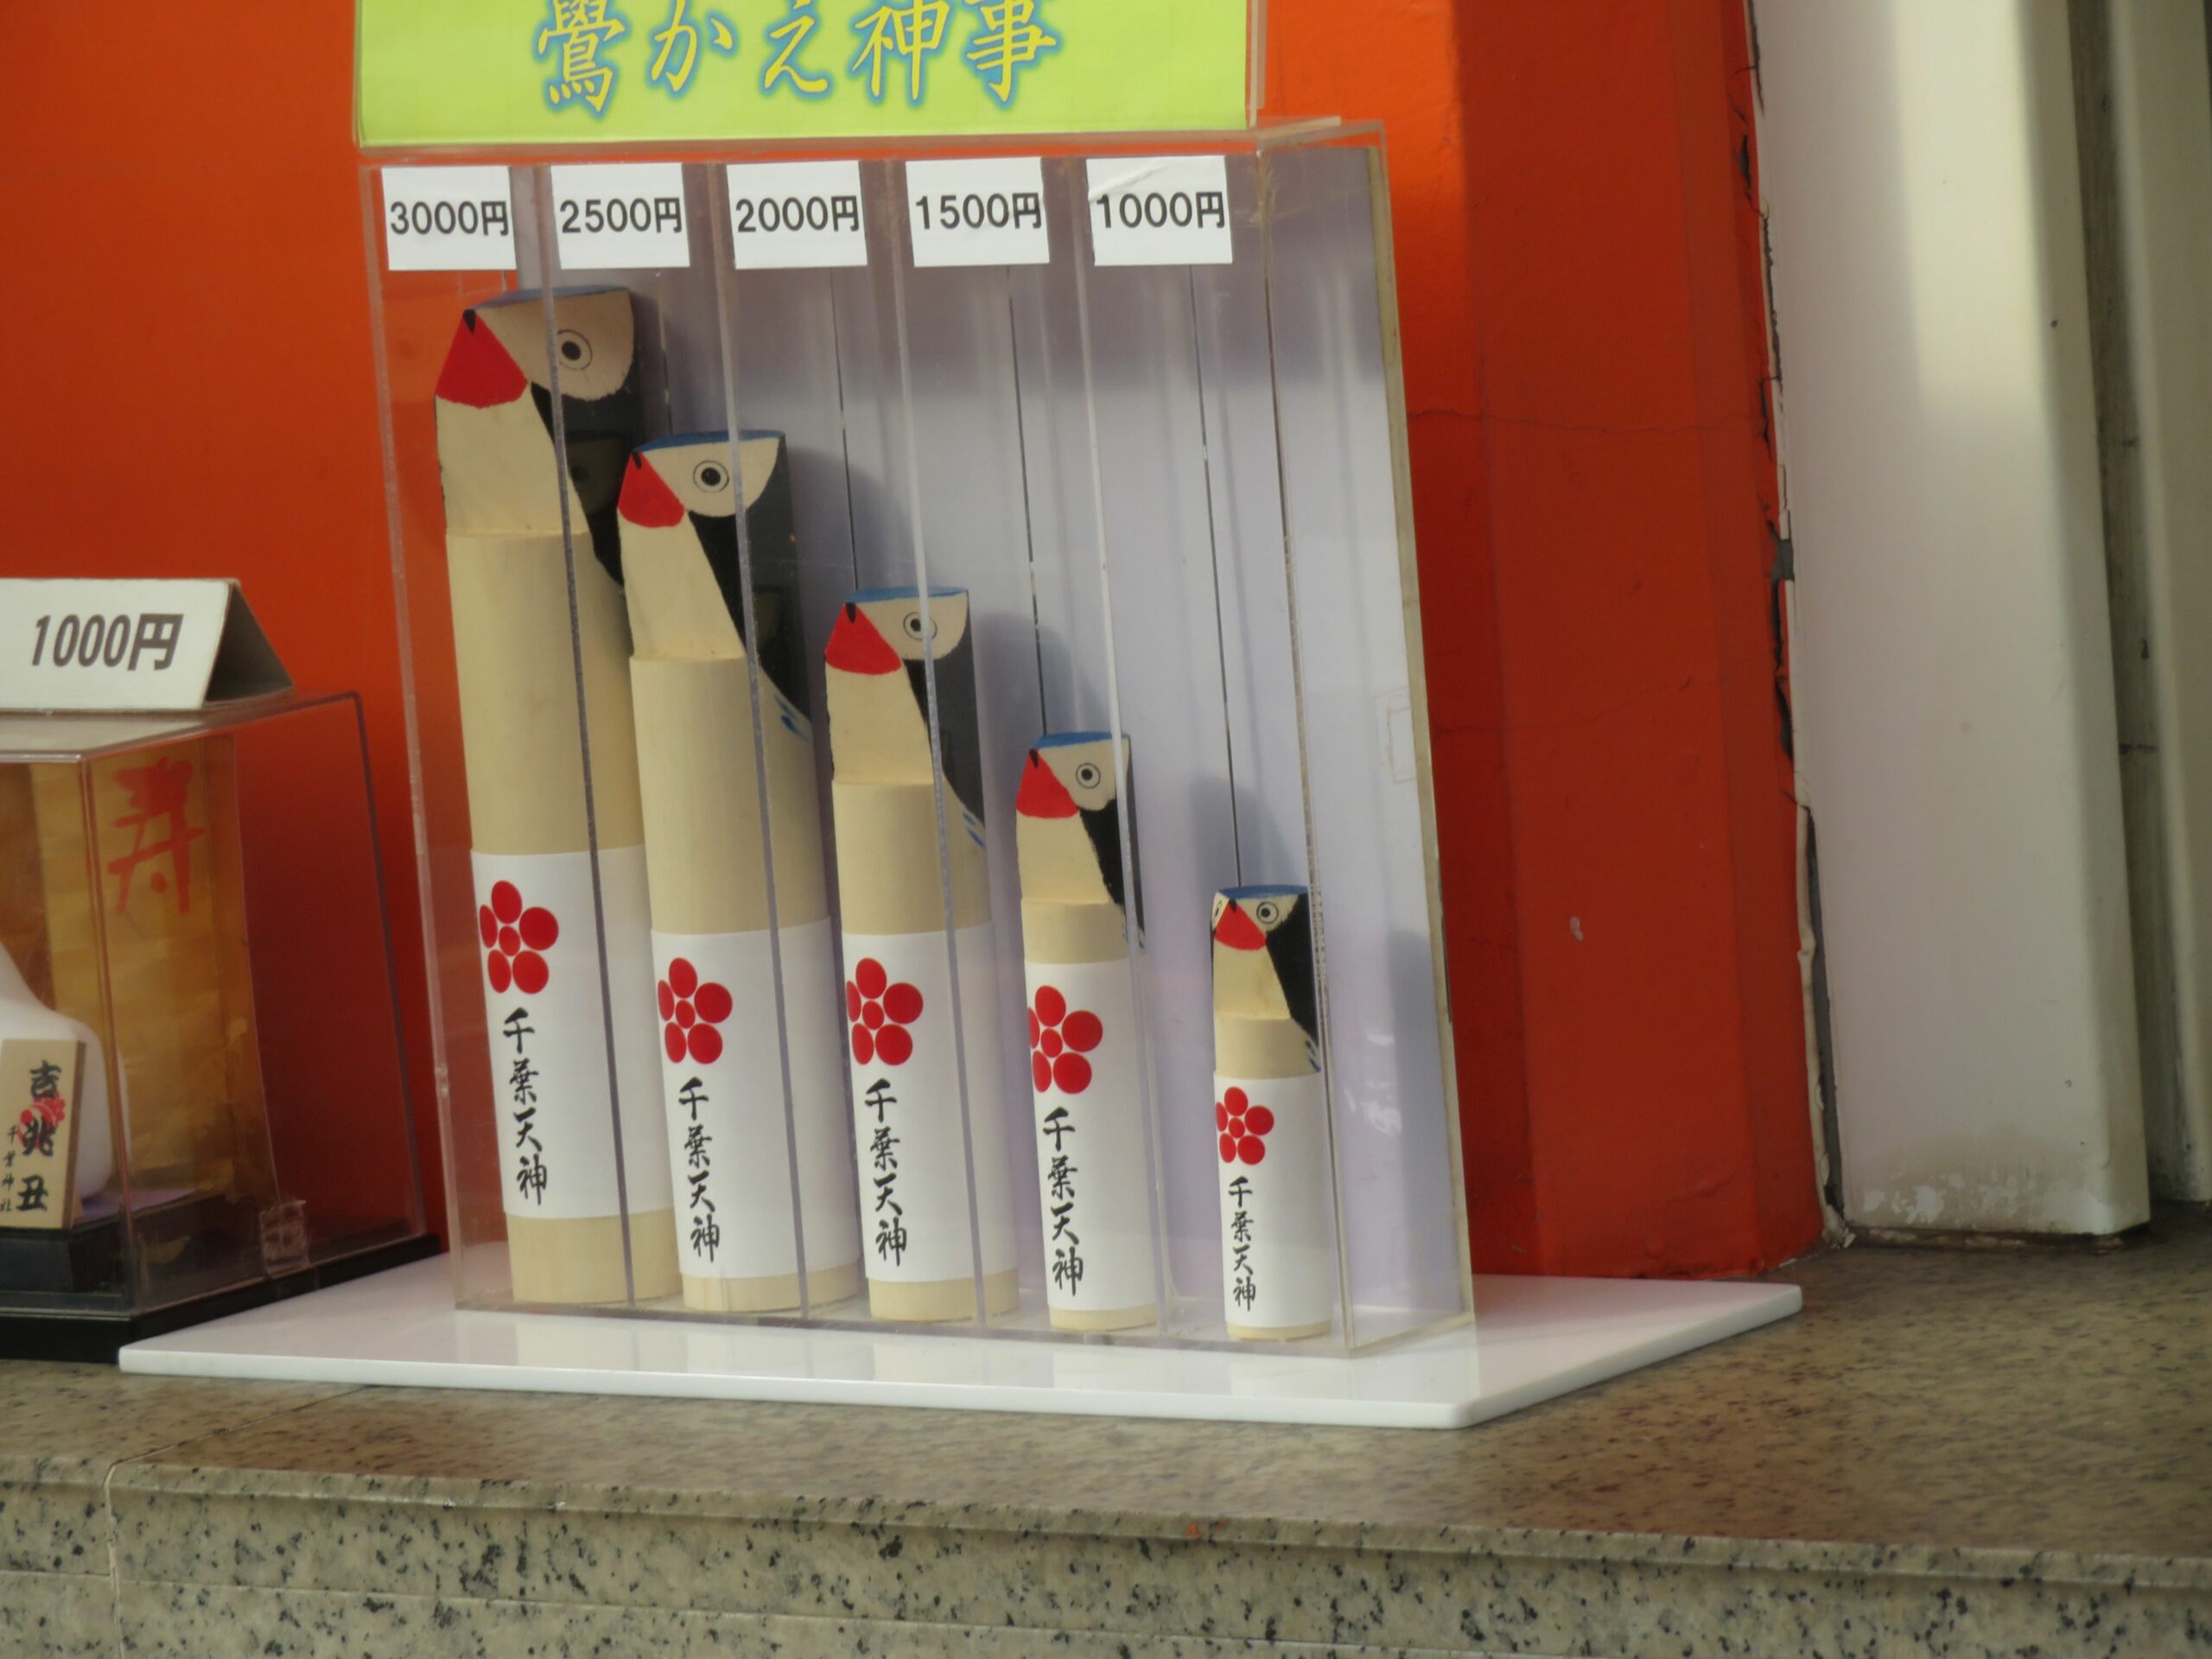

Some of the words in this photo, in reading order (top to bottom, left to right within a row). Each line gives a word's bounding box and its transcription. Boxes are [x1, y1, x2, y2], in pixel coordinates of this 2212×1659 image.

[389, 199, 509, 236] 3000円
[560, 195, 683, 233] 2500円
[735, 194, 861, 232] 2000円
[914, 191, 1042, 230] 1500円
[1095, 190, 1226, 230] 1000円
[31, 613, 183, 672] 1000円
[503, 1007, 548, 1206] 千葉天神
[677, 1076, 721, 1263] 千葉天神
[864, 1077, 907, 1267] 千葉天神
[1042, 1106, 1084, 1296] 千葉天神
[1228, 1175, 1257, 1312] 千葉天神
